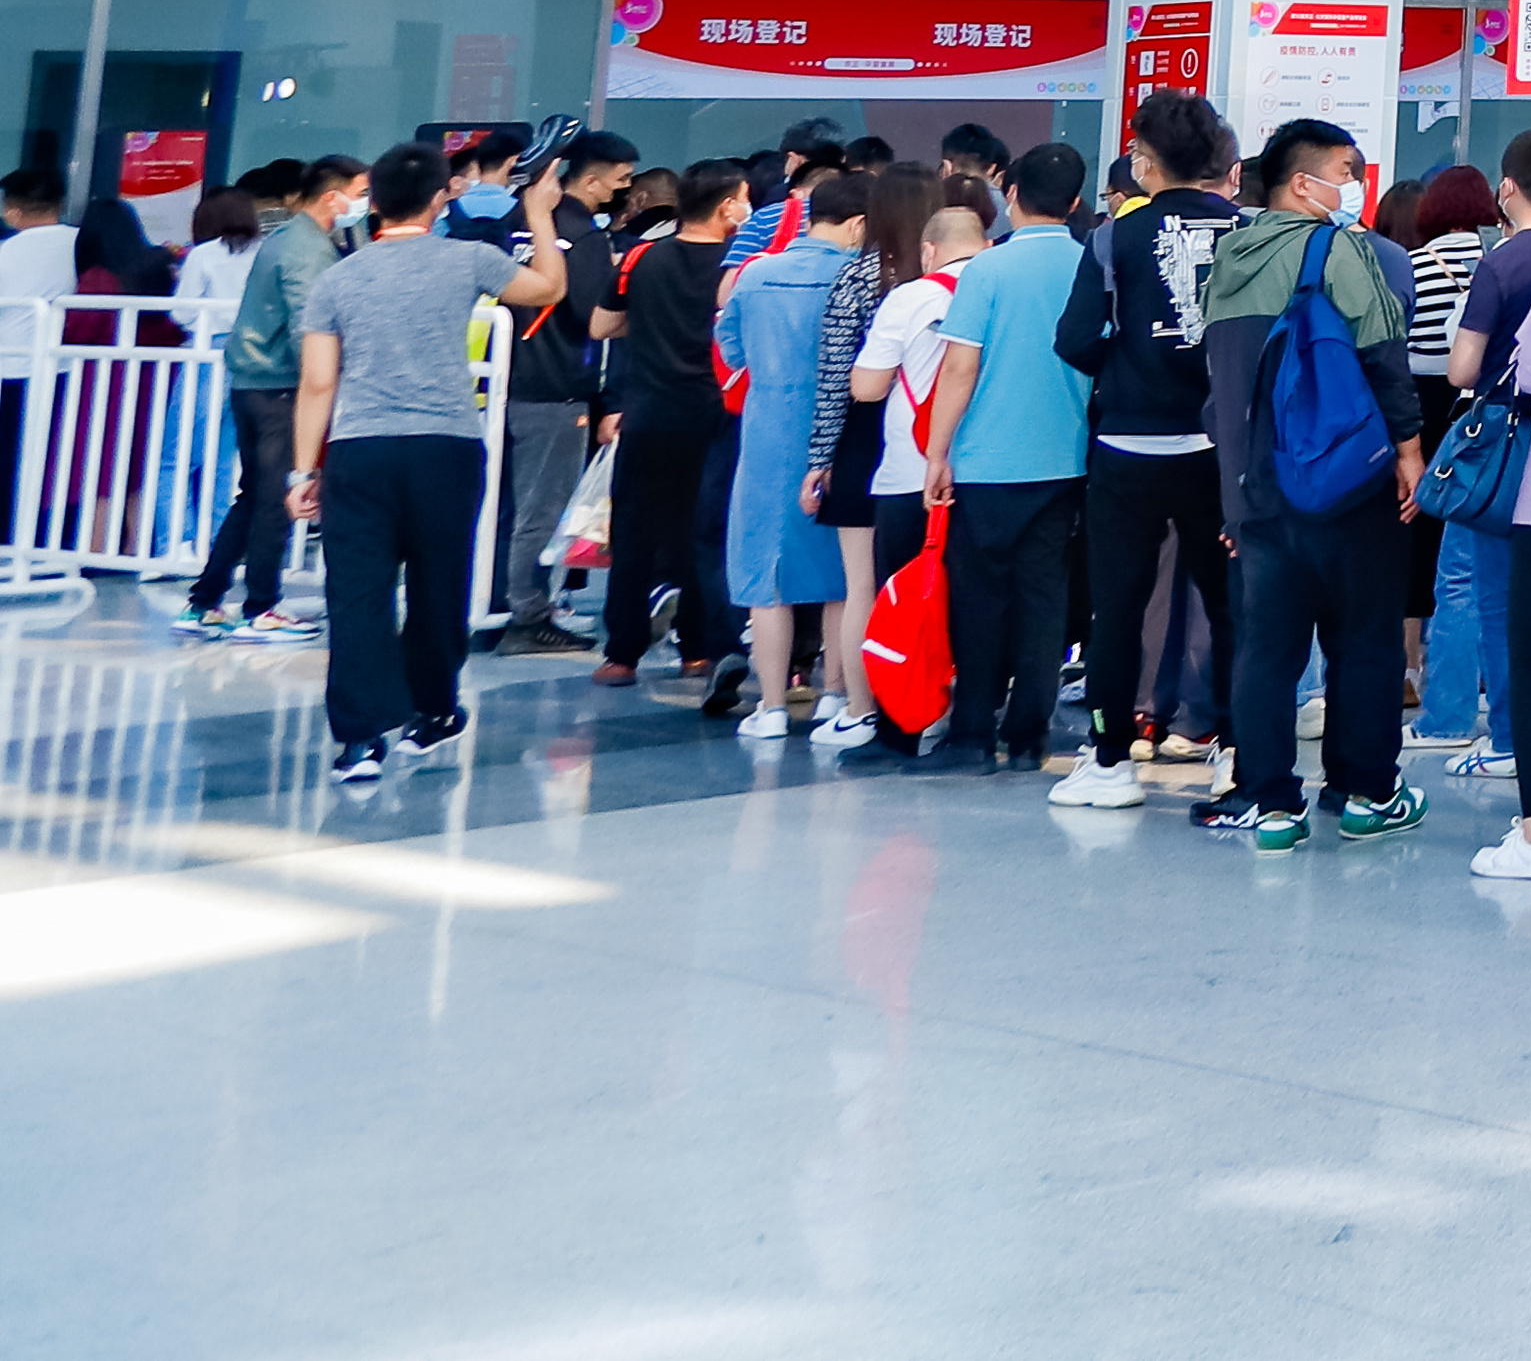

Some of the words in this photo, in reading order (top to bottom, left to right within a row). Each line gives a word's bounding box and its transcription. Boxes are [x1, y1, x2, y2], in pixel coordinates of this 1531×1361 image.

[699, 18, 808, 45] 现场登记
[932, 22, 1032, 49] 现场登记
